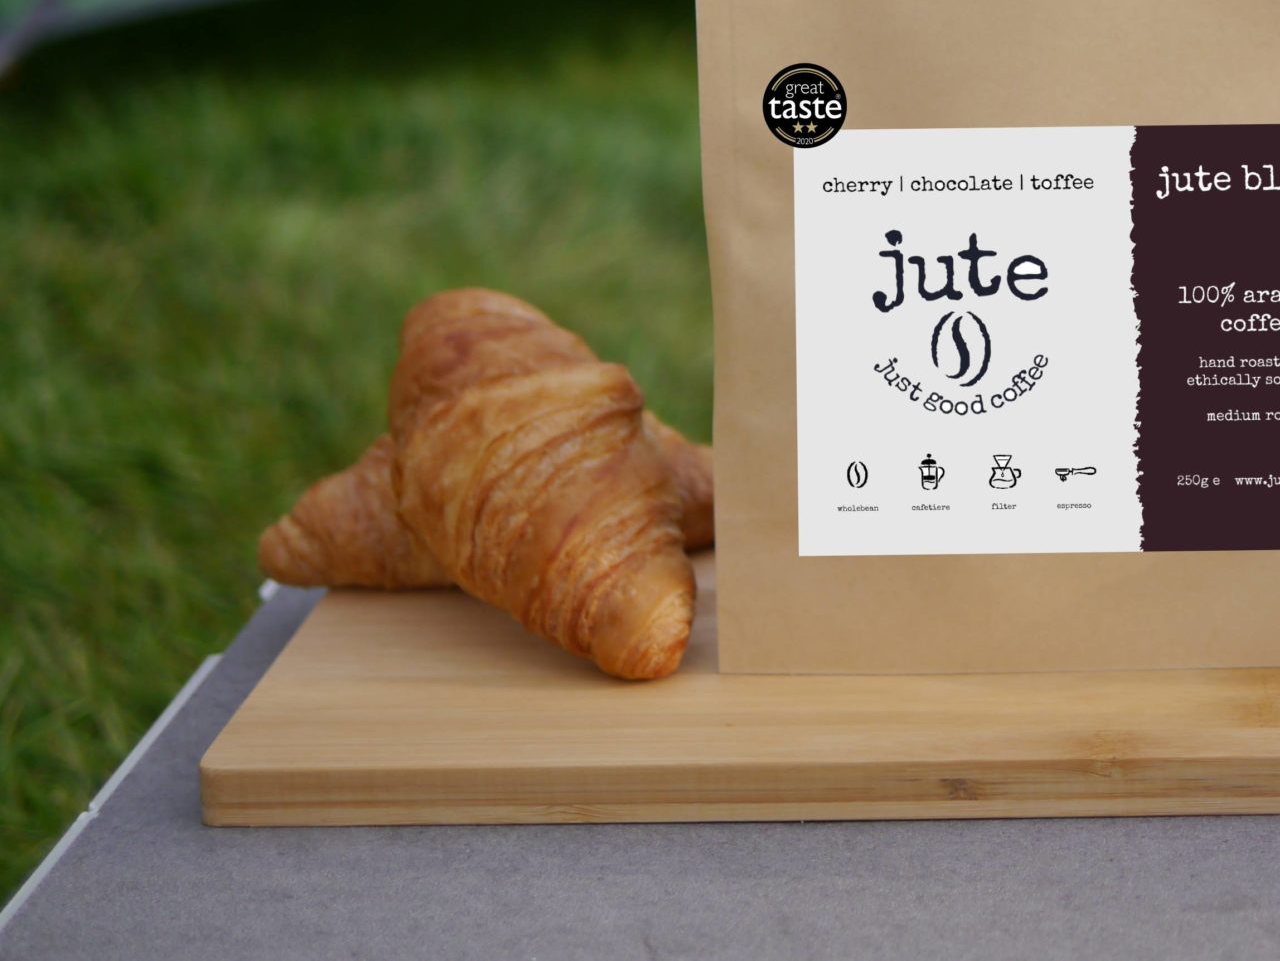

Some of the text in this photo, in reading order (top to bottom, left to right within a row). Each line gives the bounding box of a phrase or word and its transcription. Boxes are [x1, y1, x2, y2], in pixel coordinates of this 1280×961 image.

[785, 81, 824, 99] great
[796, 137, 814, 145] 2020
[822, 177, 893, 196] cherry
[910, 176, 1013, 191] chocolate
[1030, 174, 1094, 190] toffee
[1156, 165, 1231, 199] jute
[872, 230, 1049, 312] jute
[1178, 282, 1236, 307] 100%
[1199, 356, 1236, 368] hand
[873, 354, 1049, 416] just good coffee
[1186, 374, 1261, 388] ethically
[1207, 409, 1261, 421] medium
[1177, 474, 1209, 488] 250g
[991, 502, 1017, 510] filter
[1056, 502, 1092, 510] espresso
